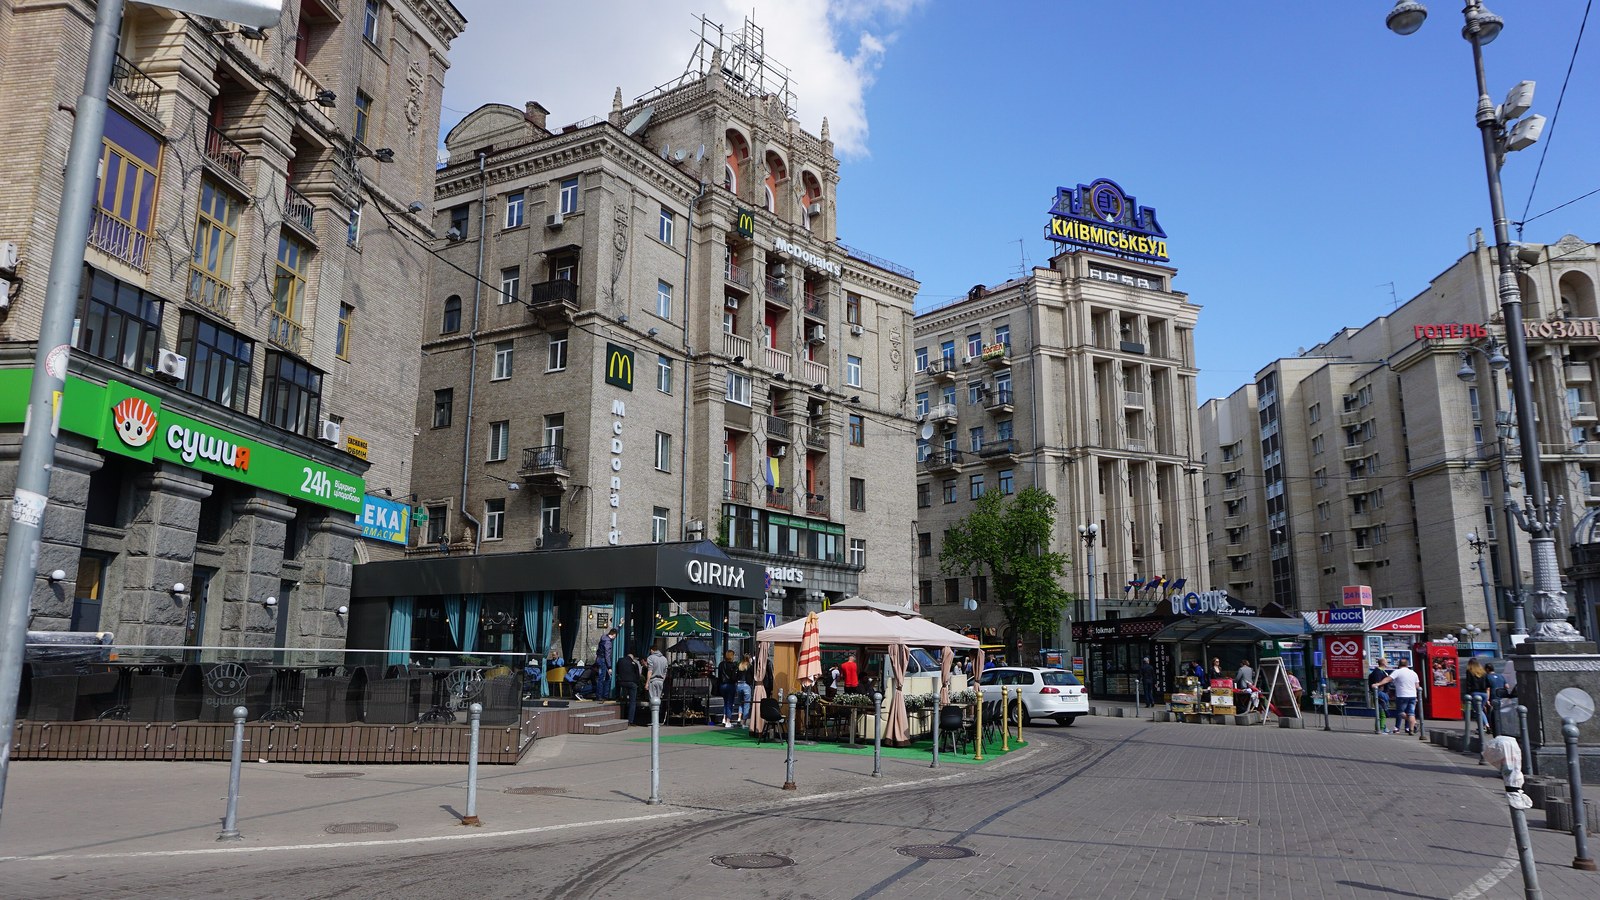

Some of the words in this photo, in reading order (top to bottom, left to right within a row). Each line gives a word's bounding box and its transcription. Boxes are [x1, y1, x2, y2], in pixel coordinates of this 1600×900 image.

[1051, 217, 1168, 259] КИЇВМІСЬКБУД
[775, 237, 841, 277] McDonald's
[1414, 322, 1488, 340] ГОТЕЛЬ
[167, 424, 250, 471] сушия
[347, 437, 368, 449] EXCHANGE
[301, 467, 331, 499] 24h
[334, 479, 357, 494] Відкрито
[687, 560, 745, 589] QIRIM
[1171, 590, 1228, 615] GLOBUS
[1331, 611, 1362, 621] КІОСК
[1095, 626, 1116, 634] folkmart
